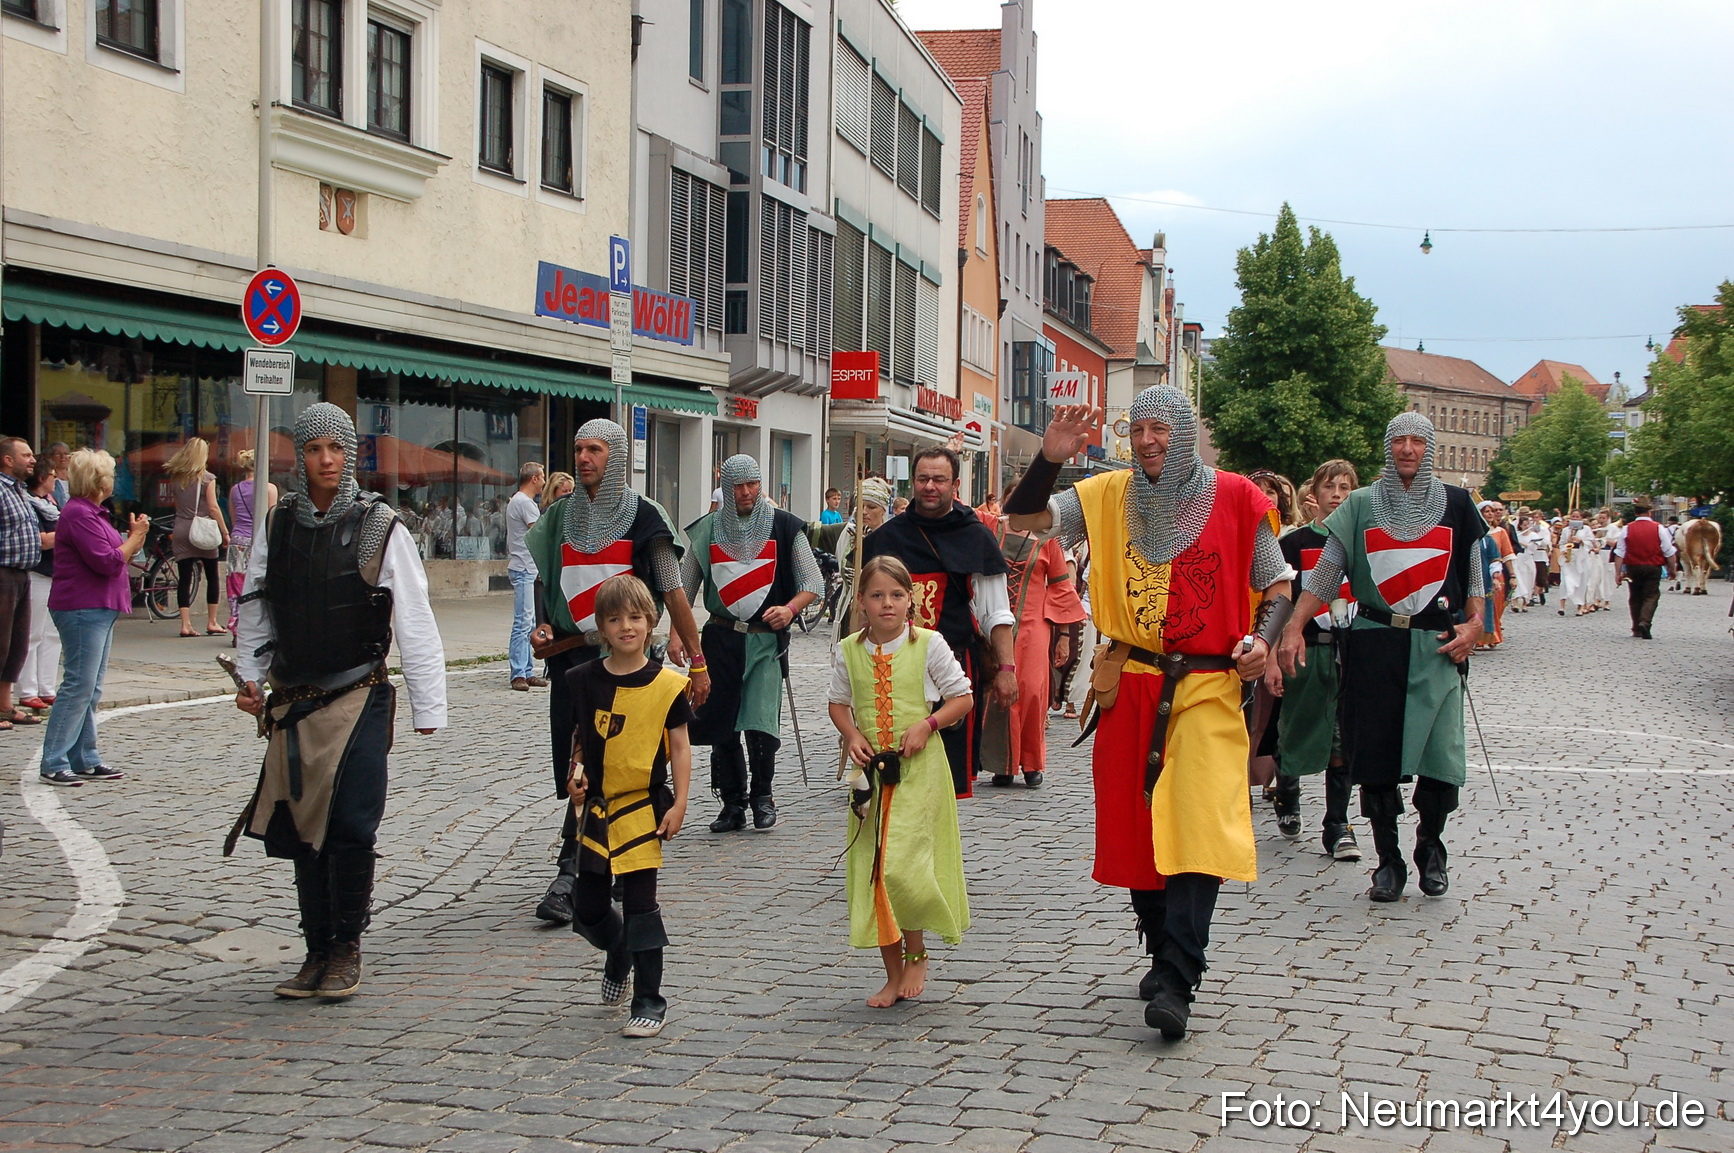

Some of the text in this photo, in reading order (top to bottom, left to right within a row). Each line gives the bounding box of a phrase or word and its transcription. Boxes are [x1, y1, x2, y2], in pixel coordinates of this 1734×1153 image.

[614, 244, 626, 285] P
[633, 290, 690, 339] Wölfl
[249, 357, 291, 370] Wendebereich
[255, 373, 283, 385] freihalten
[832, 369, 874, 382] ESPRIT
[1050, 379, 1079, 399] H&M
